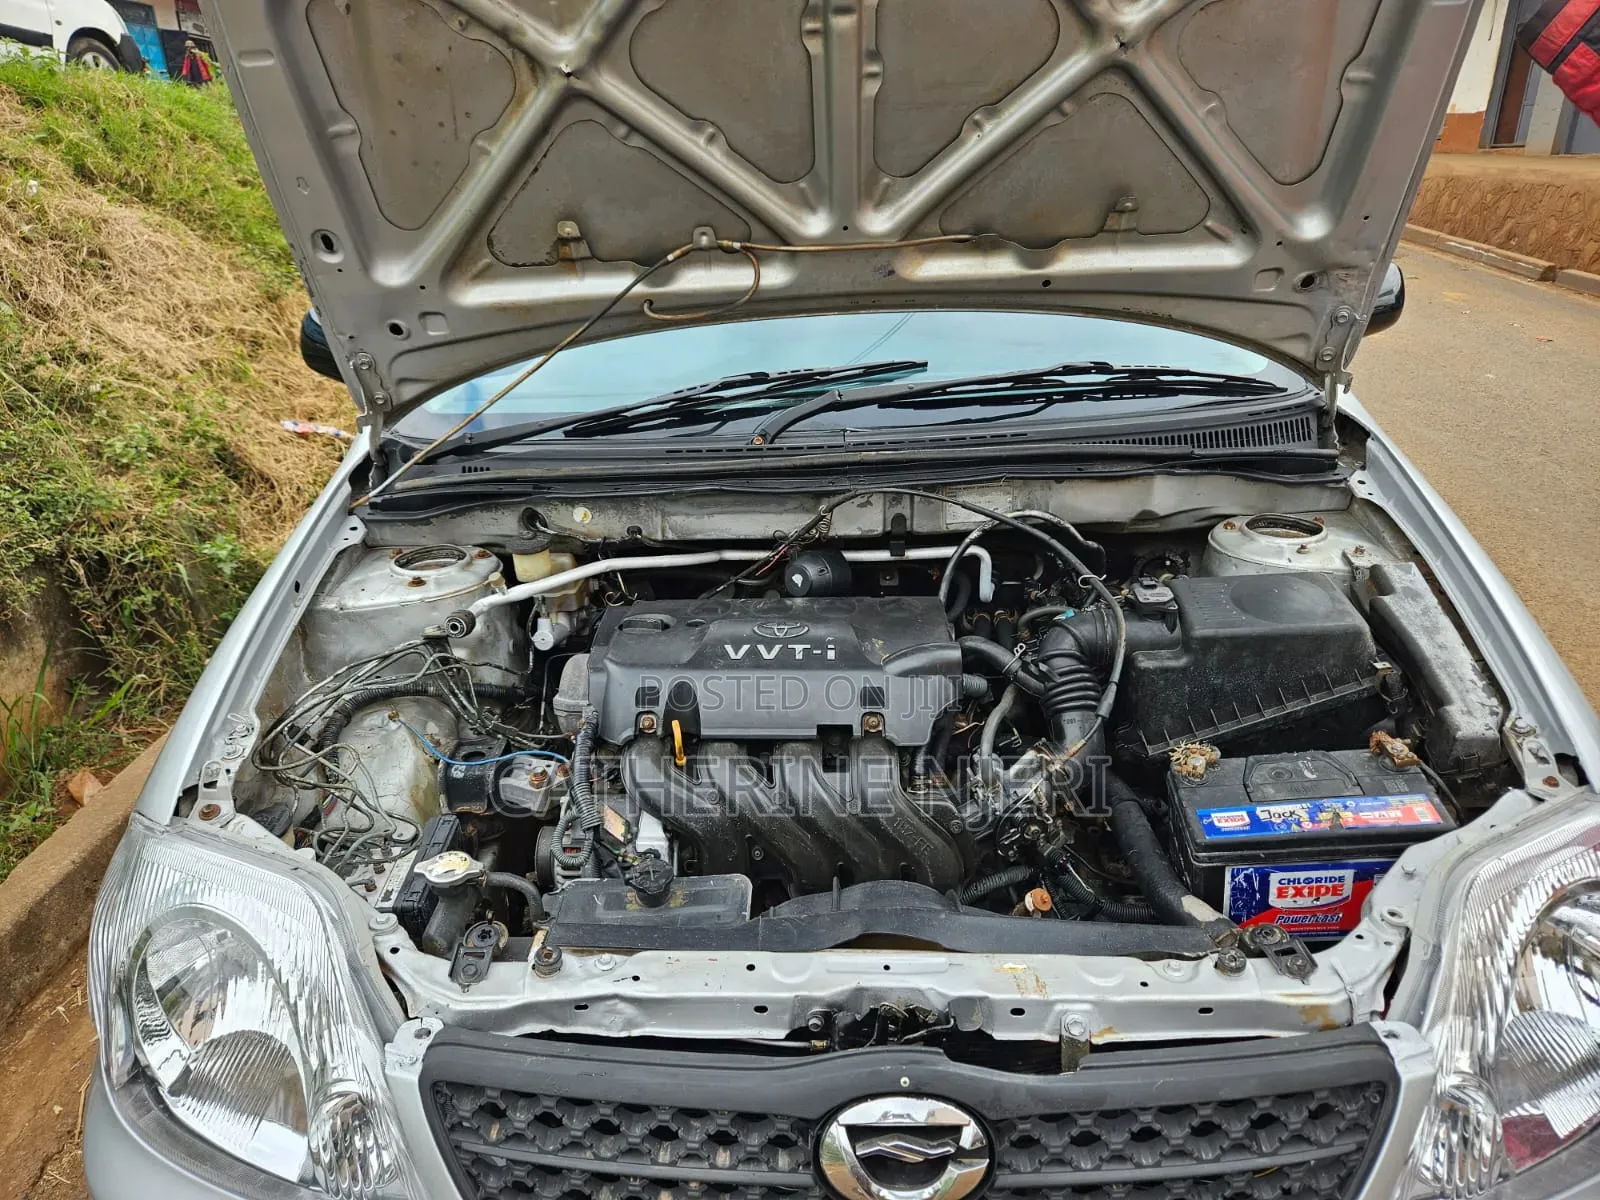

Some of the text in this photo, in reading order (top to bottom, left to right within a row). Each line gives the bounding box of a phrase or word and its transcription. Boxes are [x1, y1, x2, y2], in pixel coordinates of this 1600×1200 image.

[724, 644, 836, 660] VVT-i
[1278, 876, 1345, 885] CHLORIDE
[1276, 884, 1344, 898] EXIDE
